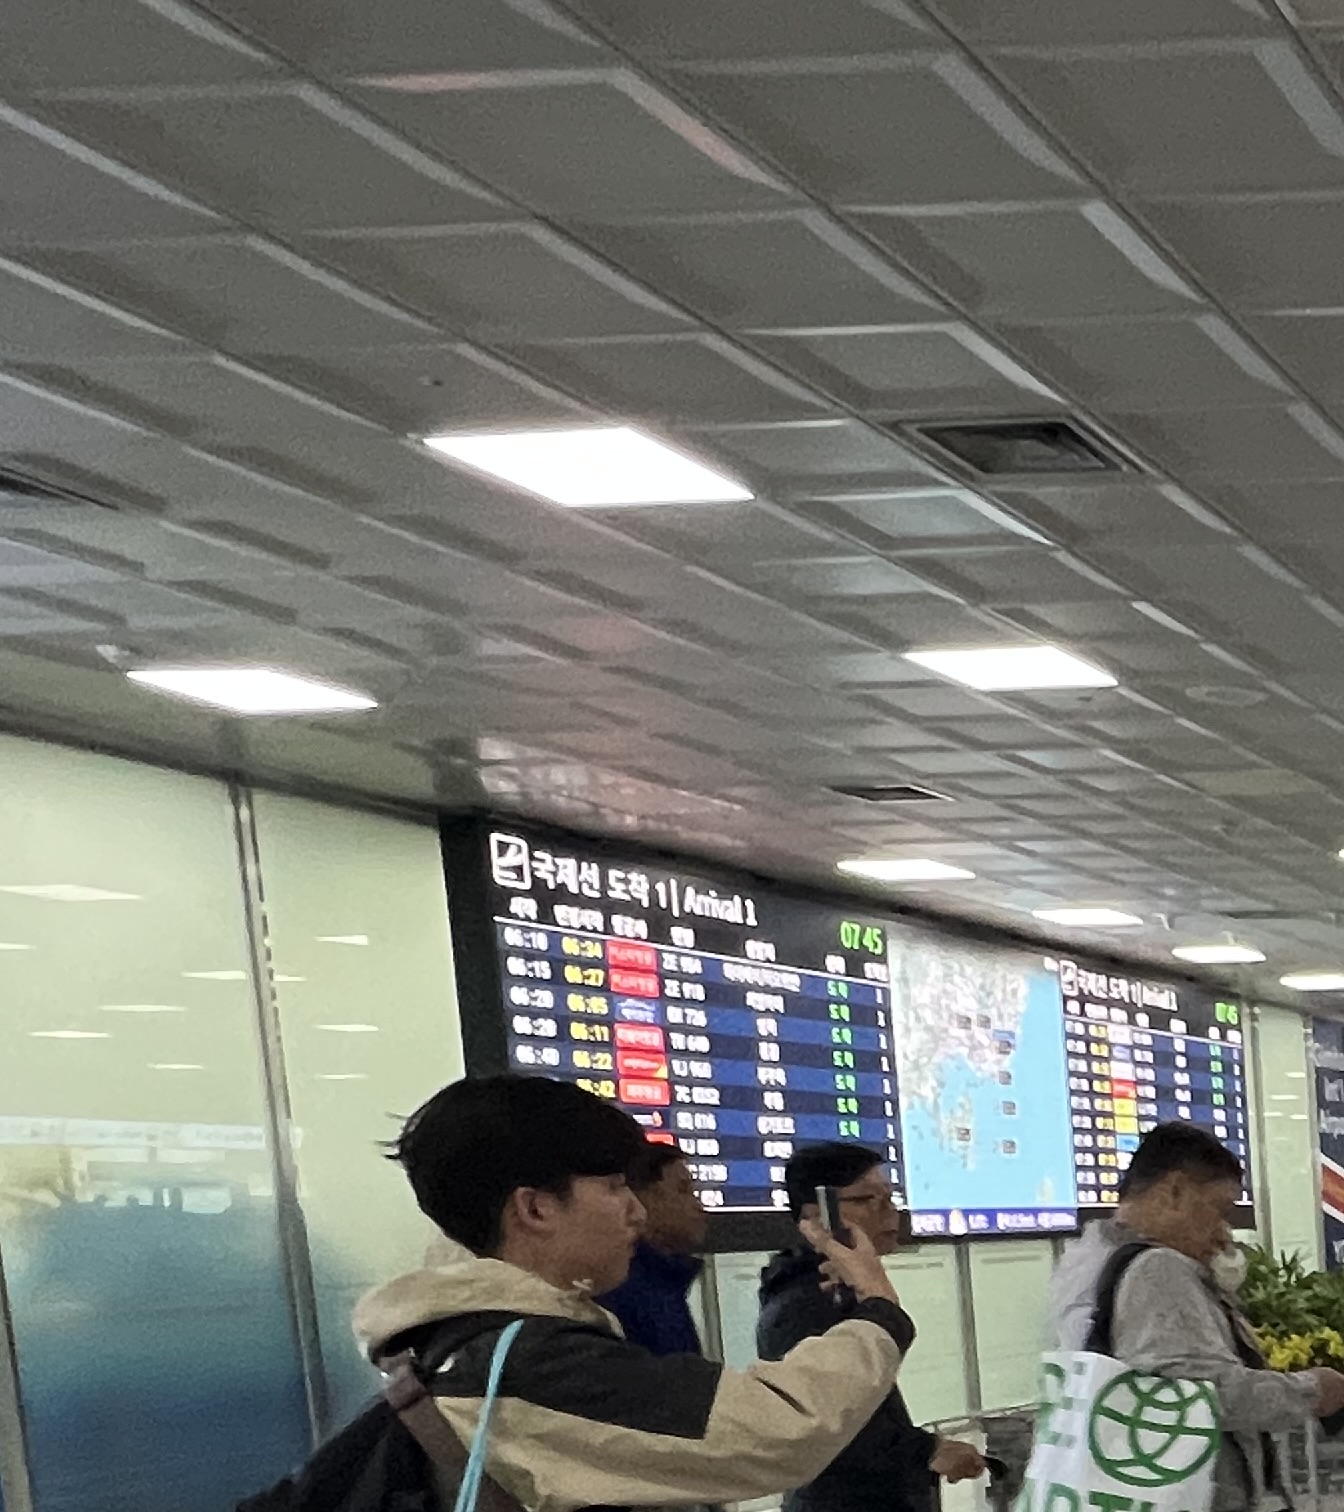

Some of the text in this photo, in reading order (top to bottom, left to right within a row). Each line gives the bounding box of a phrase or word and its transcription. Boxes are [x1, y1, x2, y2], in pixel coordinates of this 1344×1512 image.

[531, 849, 601, 899] 국제선
[606, 869, 650, 908] 도착
[655, 881, 668, 909] 1
[684, 886, 745, 925] Arrival
